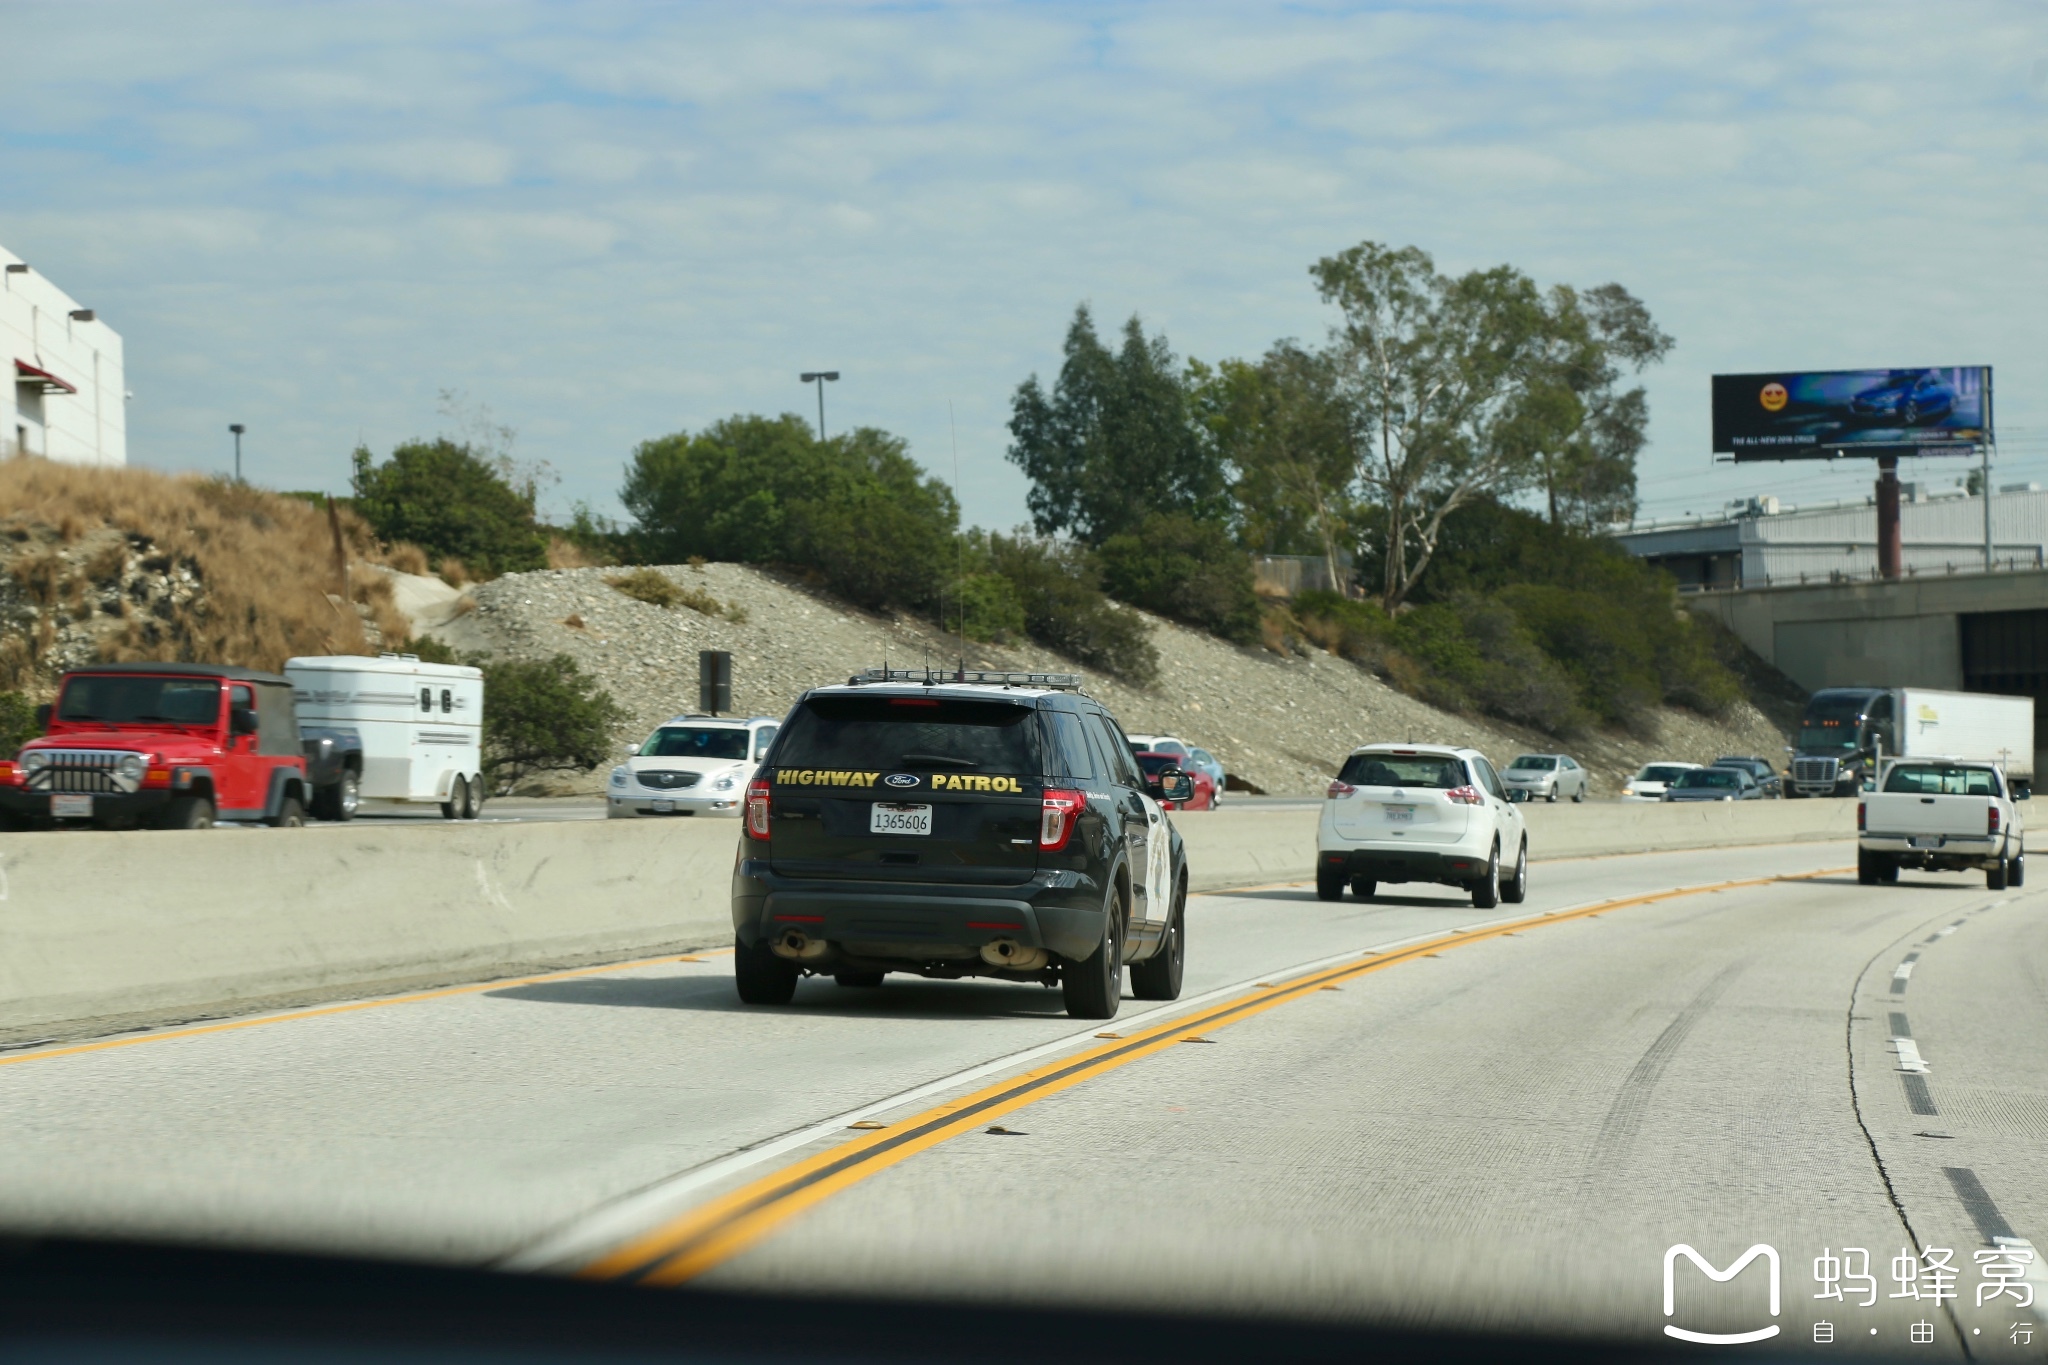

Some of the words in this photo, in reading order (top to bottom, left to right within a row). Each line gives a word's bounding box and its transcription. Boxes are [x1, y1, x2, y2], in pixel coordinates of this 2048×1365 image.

[1732, 436, 1745, 445] THE
[1746, 435, 1776, 445] ALL-NEW
[777, 770, 880, 787] HIGHWAY
[931, 774, 1022, 793] PATROL
[875, 814, 927, 829] 1365606
